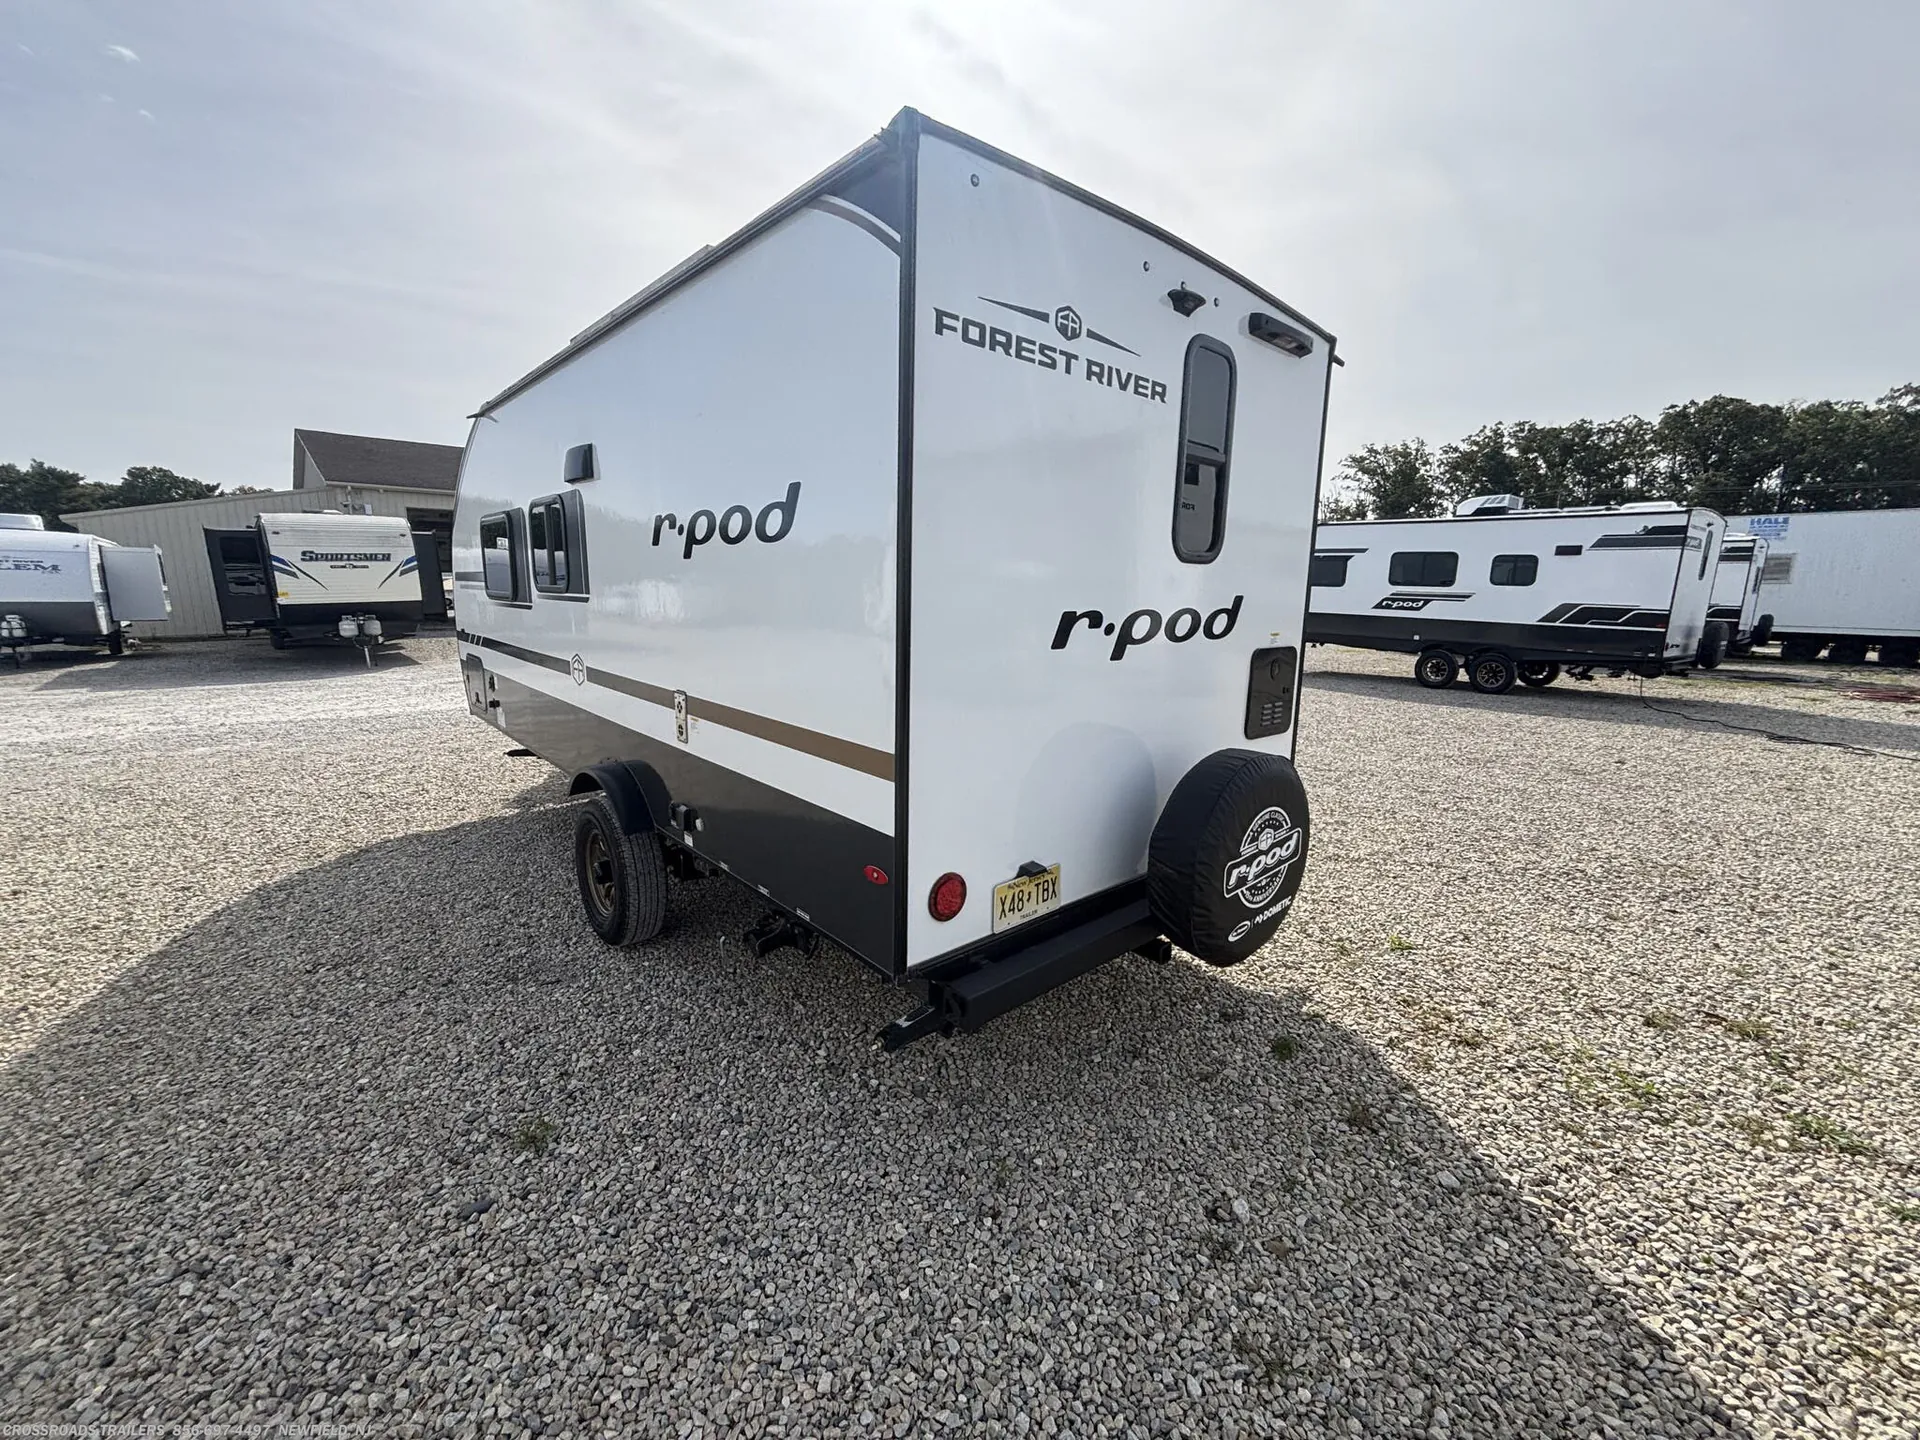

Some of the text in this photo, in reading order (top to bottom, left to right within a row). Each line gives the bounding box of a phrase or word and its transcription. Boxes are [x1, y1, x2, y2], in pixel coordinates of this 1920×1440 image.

[933, 307, 1167, 403] FOREST RIVER
[301, 550, 391, 562] SPORTSMEN
[999, 875, 1058, 921] X48 TBX
